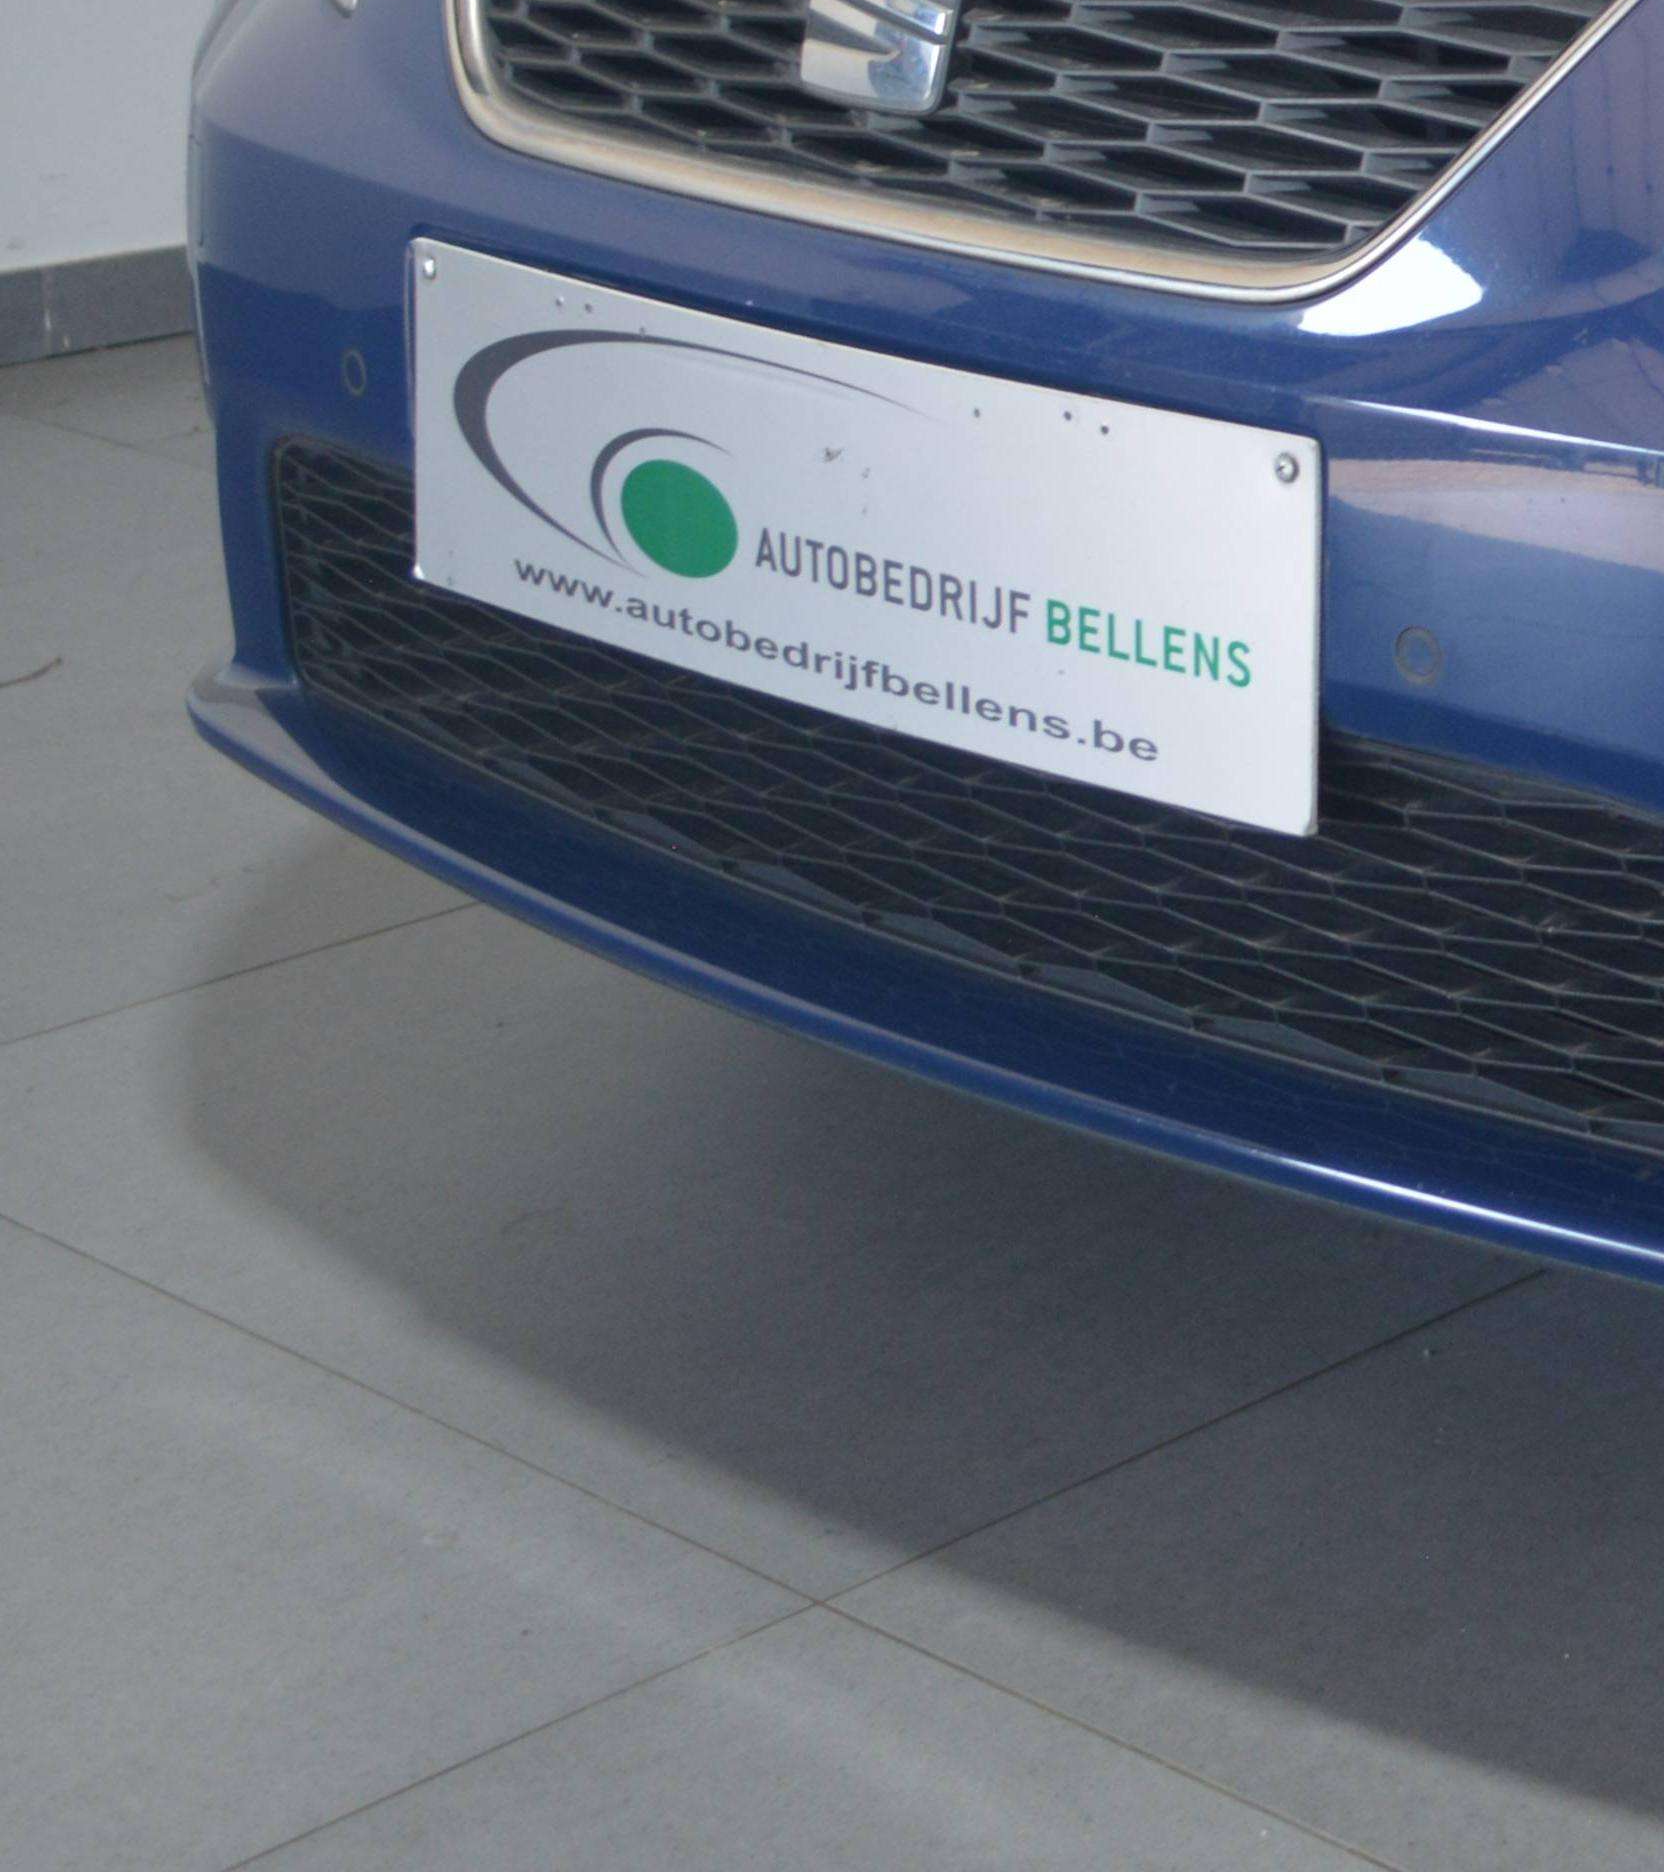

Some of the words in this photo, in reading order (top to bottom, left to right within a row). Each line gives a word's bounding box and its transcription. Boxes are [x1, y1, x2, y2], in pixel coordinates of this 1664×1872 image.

[513, 556, 1161, 764] www.autobedrijfbellens.be
[754, 526, 1032, 635] AUTOBEDRIJF
[1045, 598, 1253, 689] BELLENS
